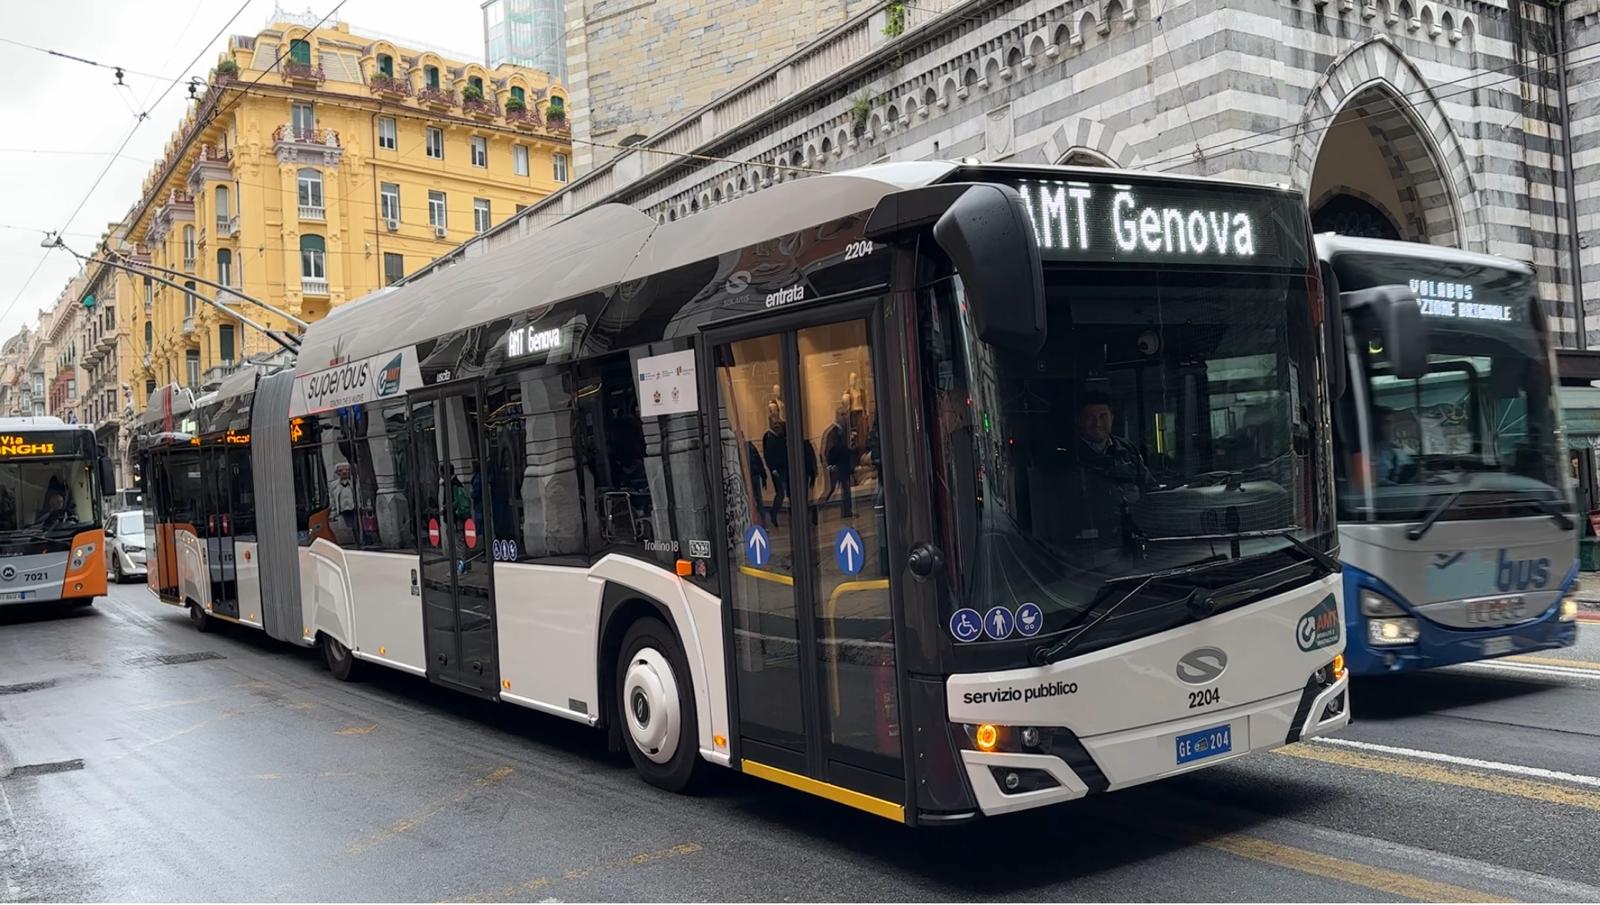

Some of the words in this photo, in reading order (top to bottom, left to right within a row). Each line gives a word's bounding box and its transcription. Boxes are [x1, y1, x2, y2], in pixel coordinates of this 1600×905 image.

[1112, 191, 1254, 256] Genova
[845, 240, 873, 260] 2204
[765, 284, 805, 308] entrata
[528, 325, 561, 352] Genova
[308, 354, 369, 406] superbus
[0, 435, 24, 445] Via
[0, 443, 55, 456] NGHI
[24, 572, 49, 582] 7021
[1316, 609, 1338, 631] AMT
[963, 686, 1023, 704] servizio
[1024, 681, 1079, 703] pubblico
[1188, 687, 1221, 709] 2204
[1179, 740, 1192, 757] GE
[1210, 731, 1229, 750] 204
